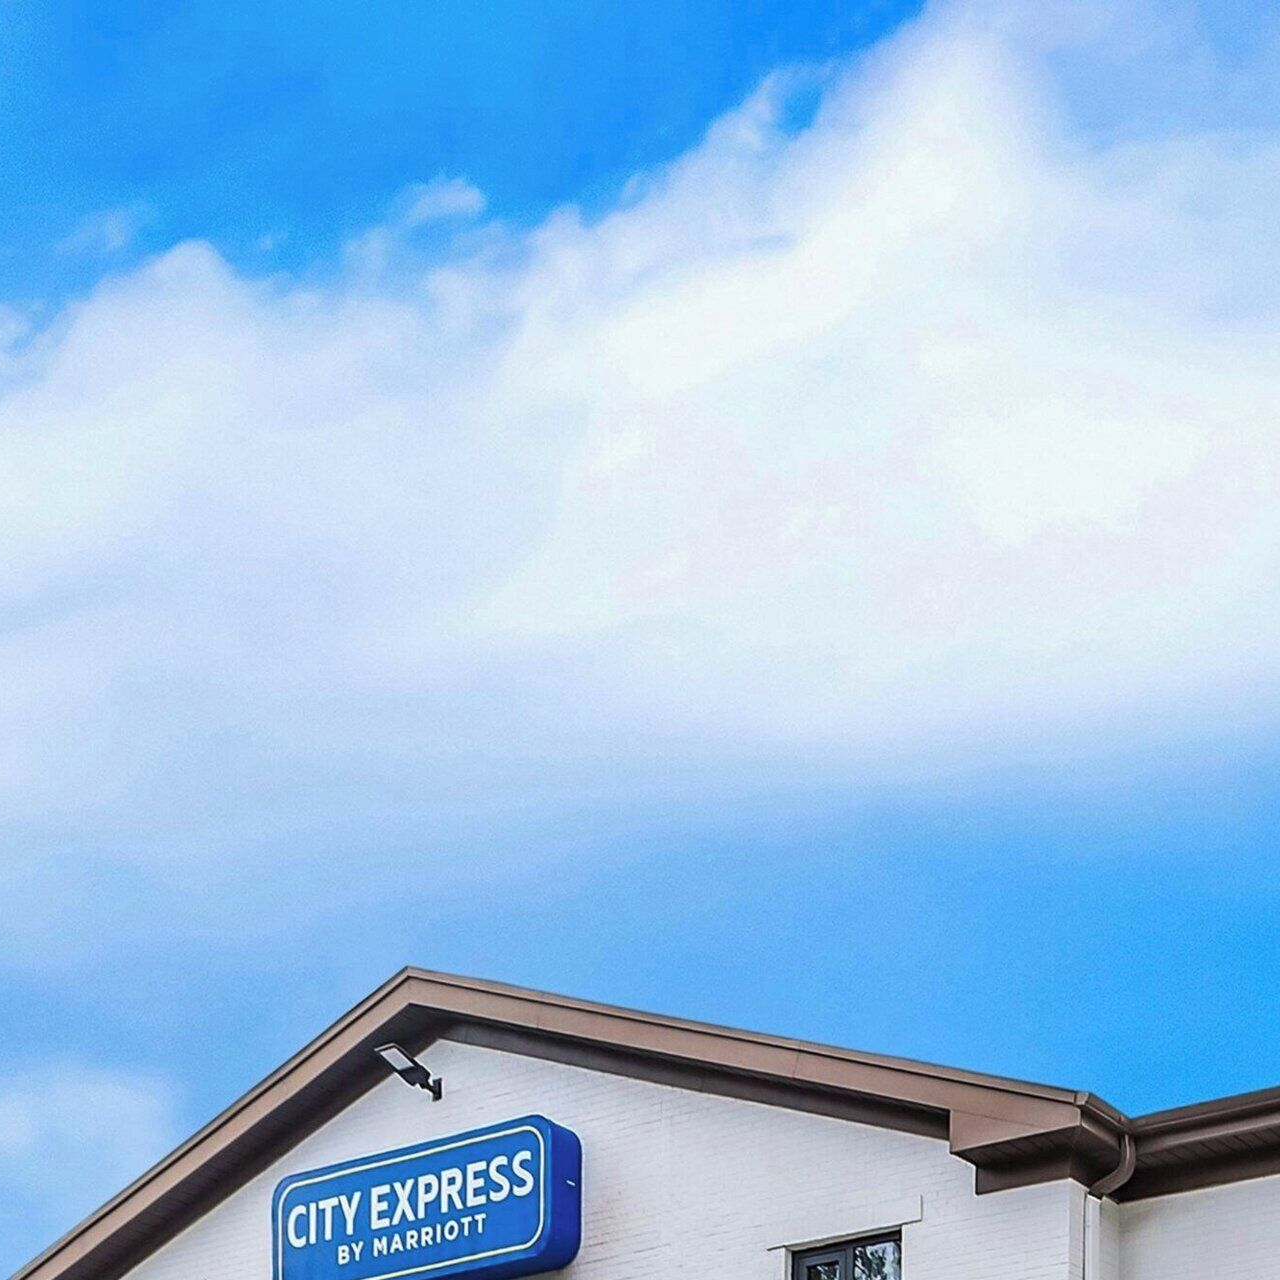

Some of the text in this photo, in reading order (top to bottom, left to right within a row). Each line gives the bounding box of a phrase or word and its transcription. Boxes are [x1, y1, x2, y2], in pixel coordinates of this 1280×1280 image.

[287, 1150, 535, 1248] CITY EXPRESS
[337, 1213, 487, 1265] BY MARRIOTT
